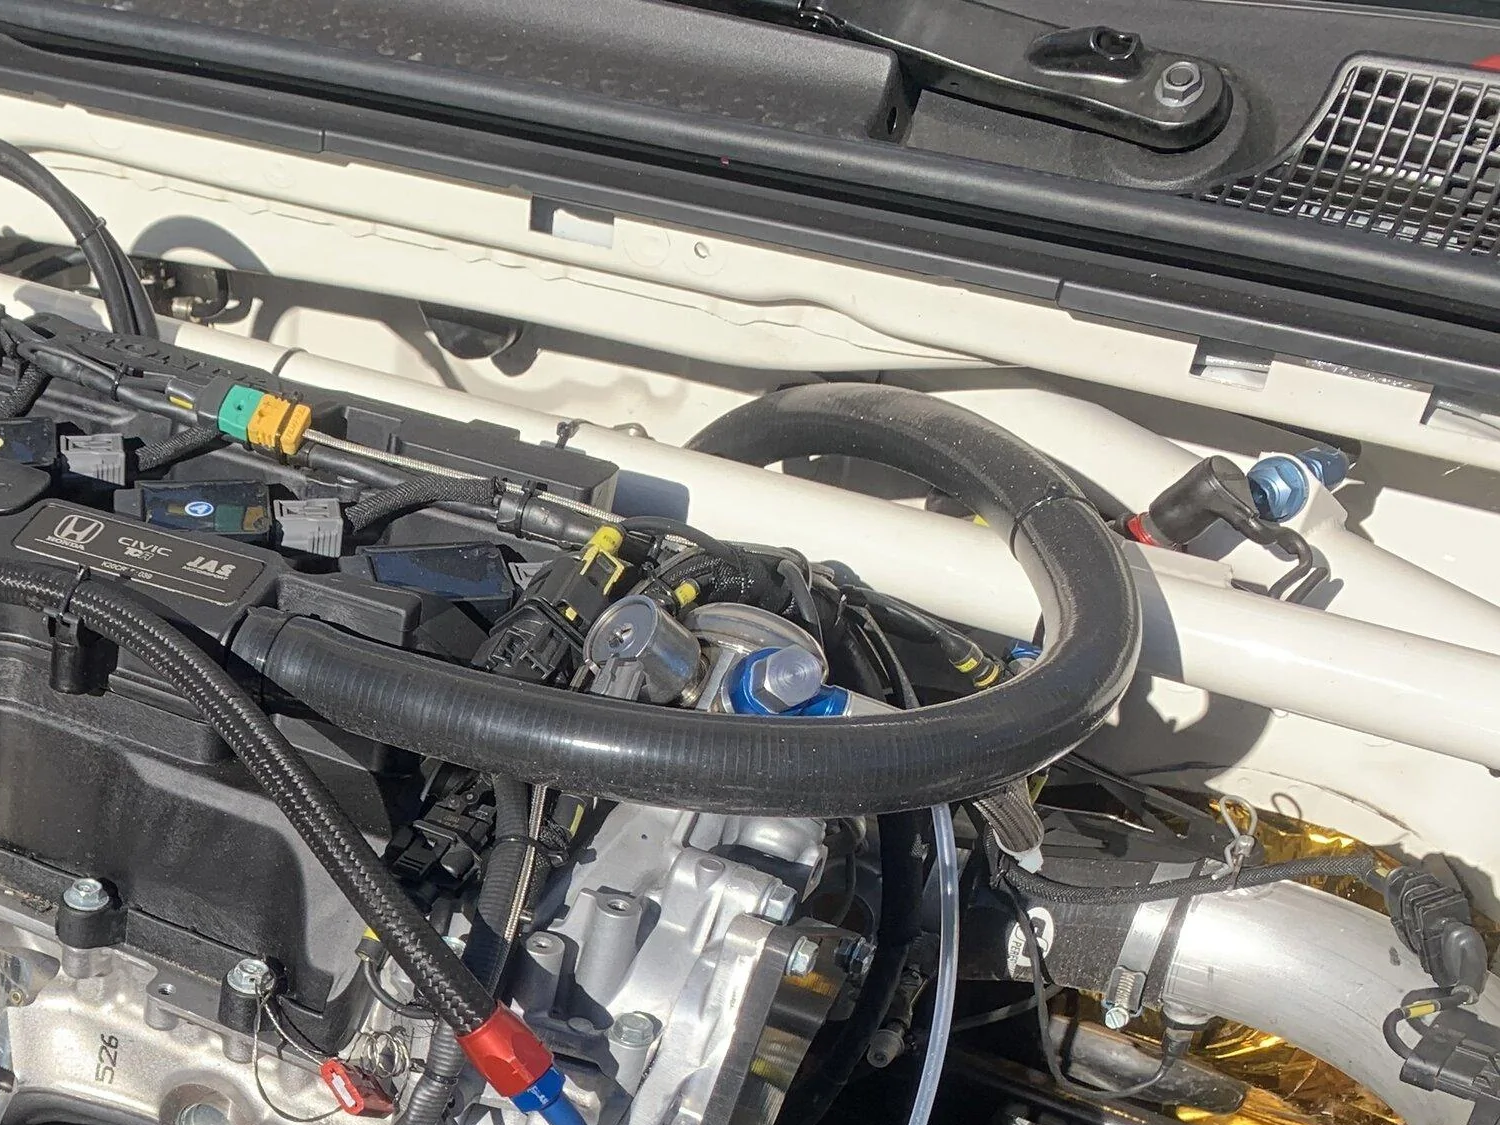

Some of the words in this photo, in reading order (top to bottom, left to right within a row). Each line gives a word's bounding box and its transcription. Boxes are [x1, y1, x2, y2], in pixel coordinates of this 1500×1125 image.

[45, 534, 86, 551] HONDA
[117, 535, 173, 558] CIVIC
[186, 555, 237, 577] JAS
[95, 1033, 119, 1085] 526
